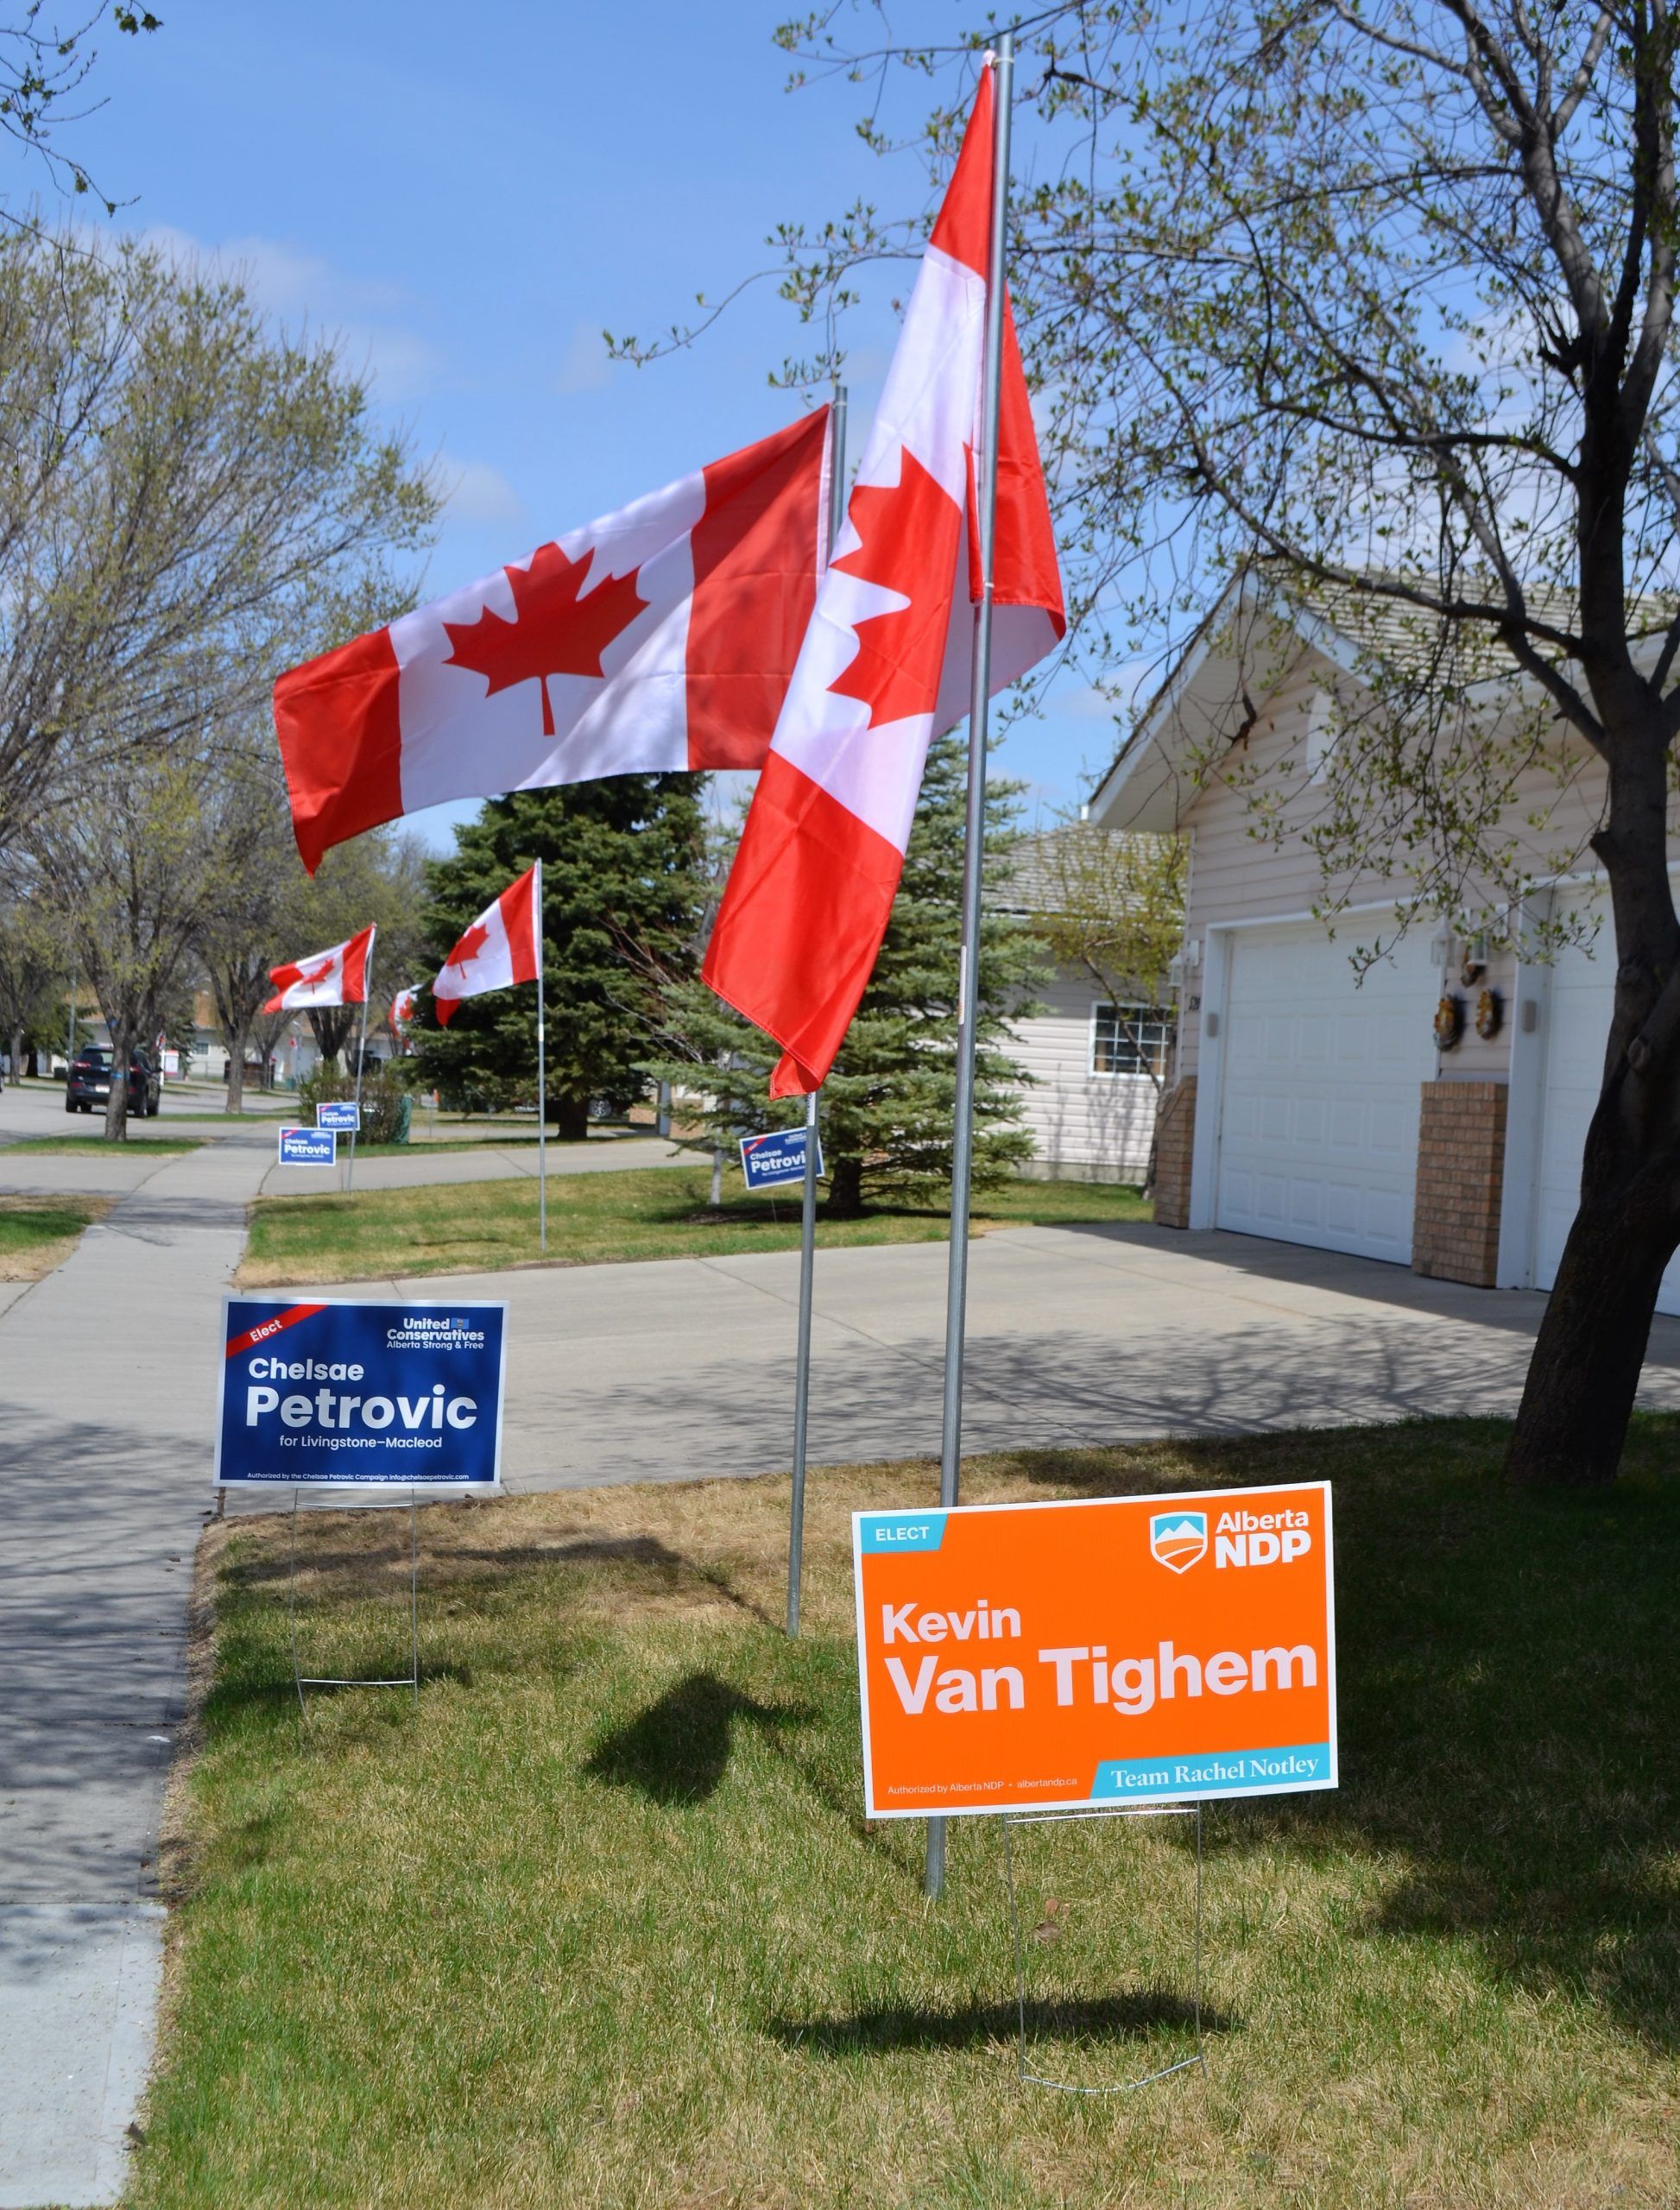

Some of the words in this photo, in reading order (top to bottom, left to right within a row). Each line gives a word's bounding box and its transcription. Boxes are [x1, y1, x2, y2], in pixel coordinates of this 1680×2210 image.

[321, 1114, 356, 1123] Petrovic
[284, 1144, 331, 1154] Petrovic
[750, 1150, 806, 1173] Petrovi
[249, 1319, 283, 1342] Elect
[403, 1317, 451, 1329] United
[386, 1341, 420, 1349] Alberta
[422, 1341, 453, 1351] Strong
[464, 1341, 484, 1349] Free
[387, 1329, 485, 1341] Conservatives
[249, 1357, 364, 1380] Chelsae
[246, 1384, 477, 1430] Petrovic
[280, 1436, 298, 1447] for
[1216, 1509, 1309, 1533] Alberta
[875, 1525, 930, 1542] ELECT
[1216, 1530, 1311, 1569] NDP
[881, 1599, 1021, 1644] Kevin
[884, 1655, 1025, 1714] Van
[1038, 1640, 1317, 1715] Tighem
[1110, 1768, 1171, 1789] Team
[1174, 1760, 1246, 1784] Rachel
[1249, 1755, 1319, 1782] Notley
[887, 1784, 936, 1796] Authorized
[937, 1784, 947, 1794] by
[950, 1783, 982, 1792] Alberta
[983, 1781, 1004, 1790] NDP
[1017, 1777, 1077, 1790] albertandp.ca
